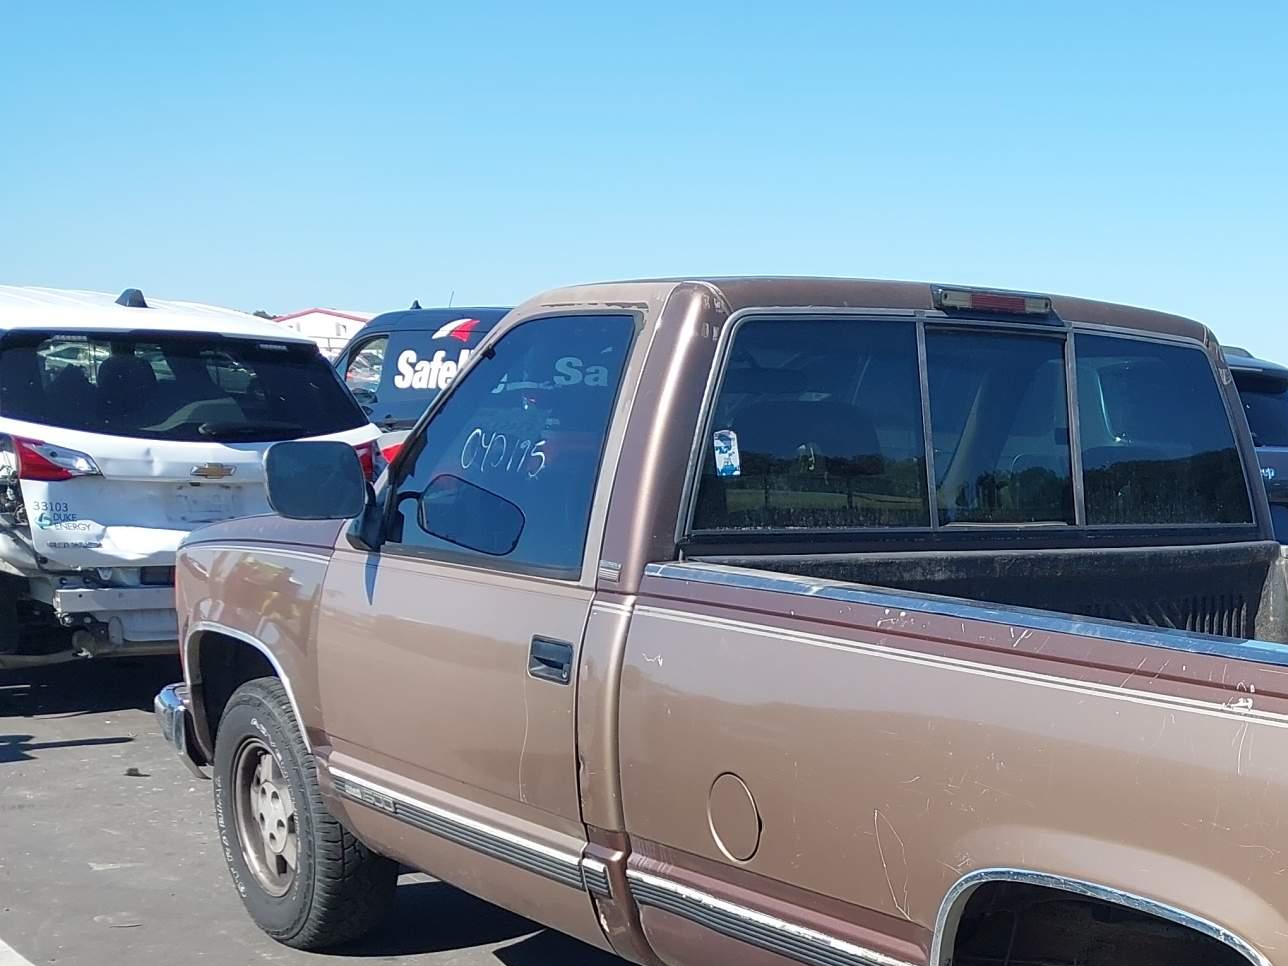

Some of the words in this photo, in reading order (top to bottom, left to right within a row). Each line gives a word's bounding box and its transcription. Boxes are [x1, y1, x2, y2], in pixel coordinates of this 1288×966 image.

[33, 501, 69, 512] 33103
[52, 512, 77, 522] DUKE
[54, 520, 91, 531] ENERGY
